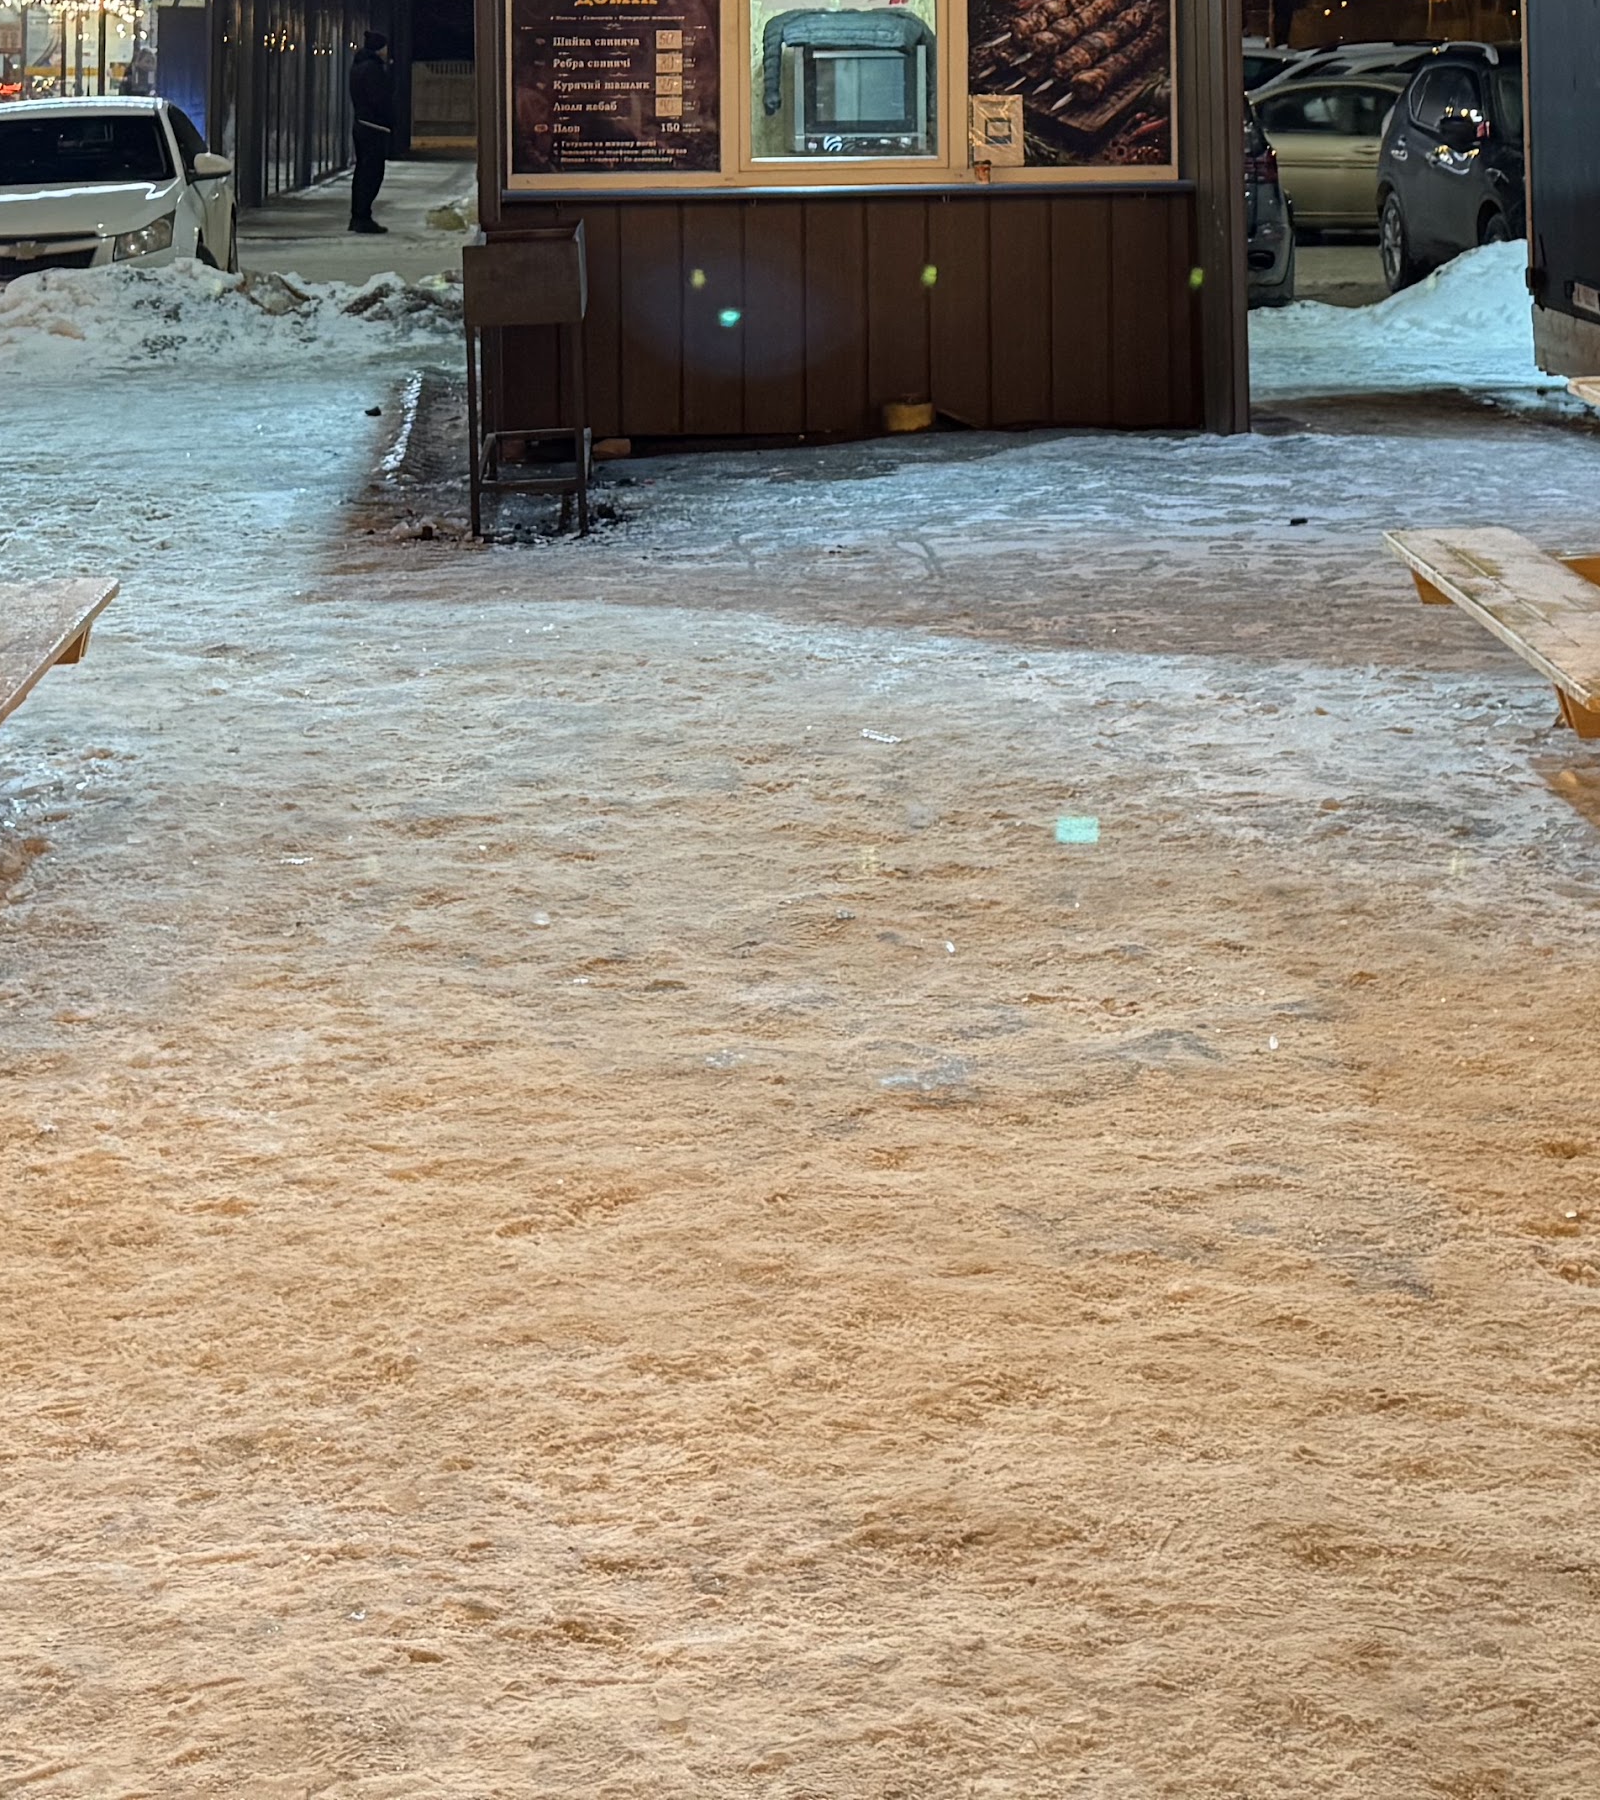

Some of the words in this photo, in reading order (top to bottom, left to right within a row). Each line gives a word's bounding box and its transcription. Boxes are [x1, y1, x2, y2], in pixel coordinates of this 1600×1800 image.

[552, 36, 592, 46] Шийка
[552, 58, 584, 70] Ребра
[552, 80, 601, 92] Курячий
[604, 81, 650, 90] шашлик
[552, 124, 581, 133] Плов
[660, 122, 680, 133] 150
